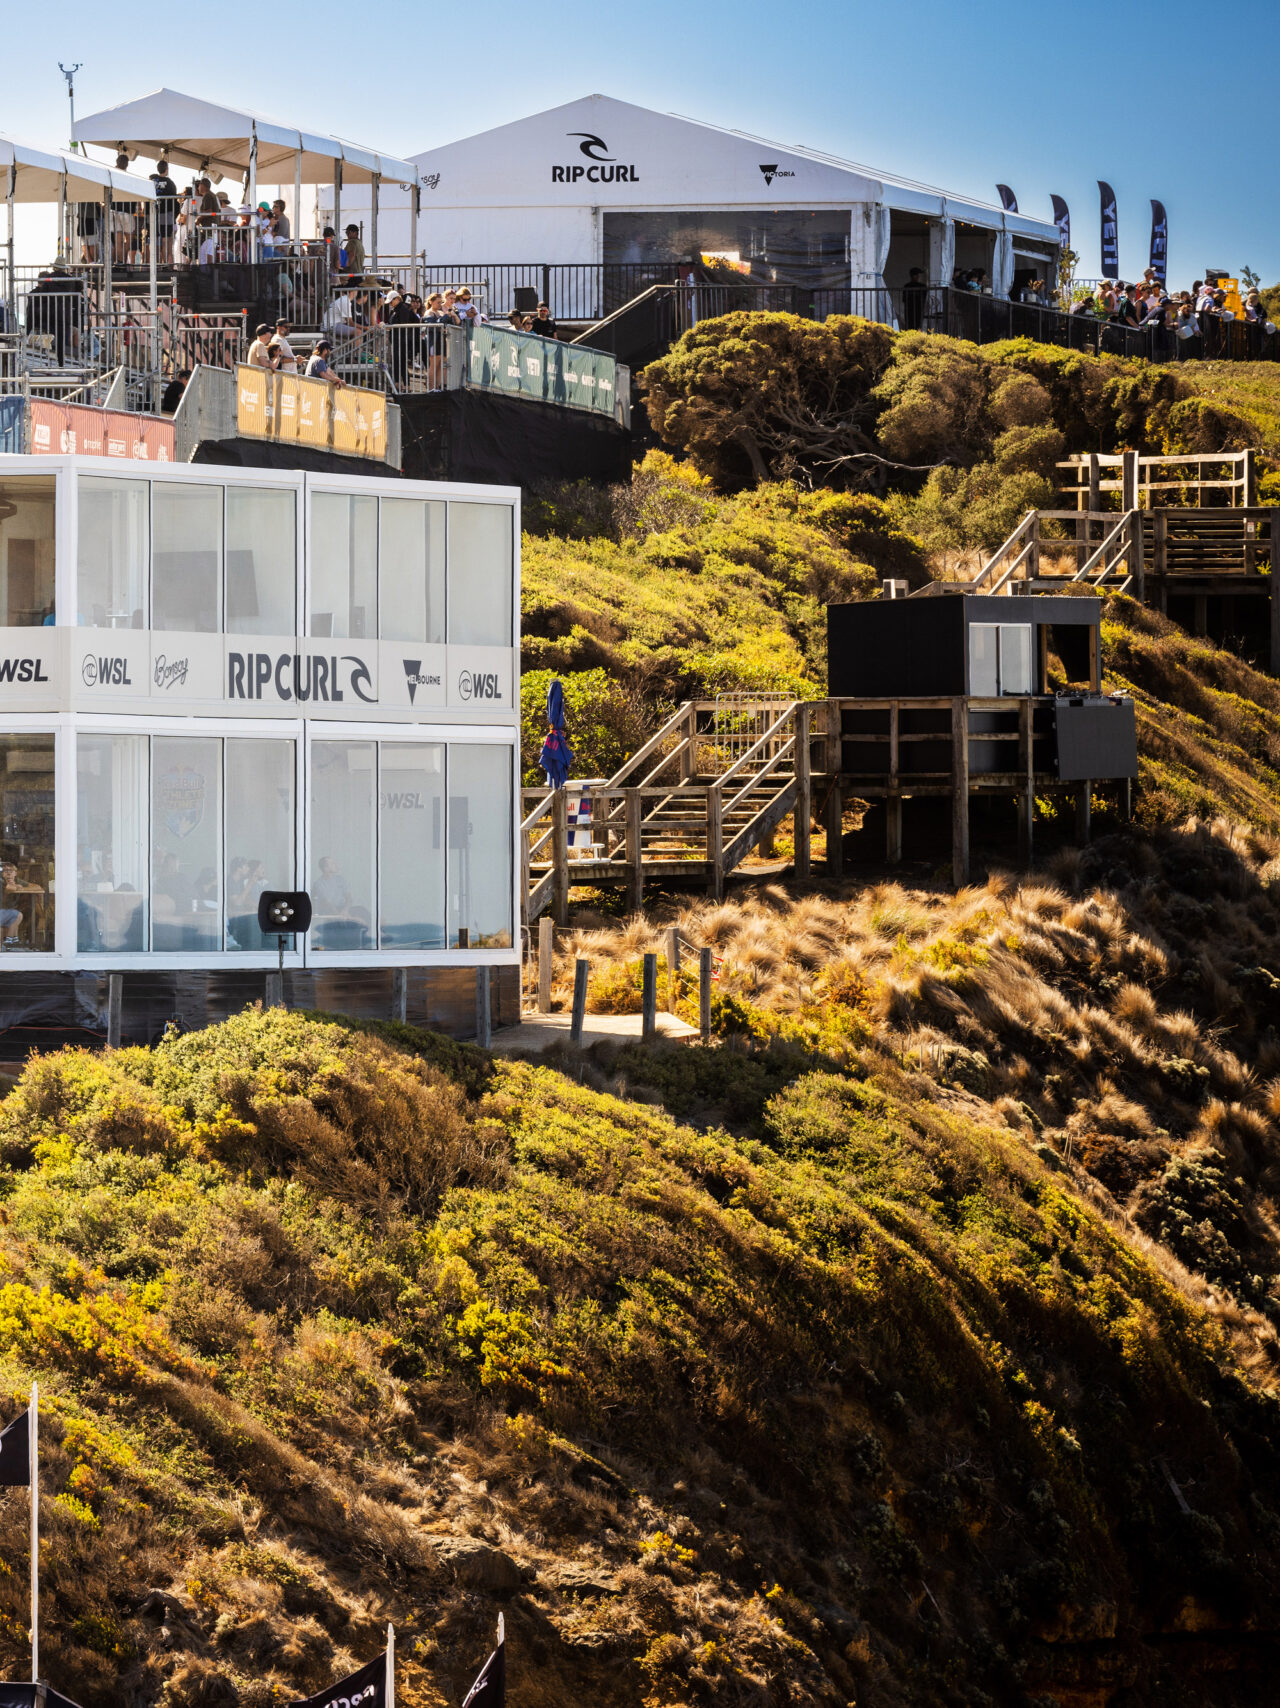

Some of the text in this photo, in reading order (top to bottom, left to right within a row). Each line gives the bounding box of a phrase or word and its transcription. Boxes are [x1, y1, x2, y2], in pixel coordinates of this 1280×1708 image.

[551, 164, 639, 183] RIPCURL
[1103, 200, 1118, 265] YETI
[98, 657, 131, 685] WSL
[154, 654, 188, 690] Bonsoy
[228, 652, 344, 701] RIPCURL
[473, 673, 502, 699] WSL
[387, 793, 425, 809] WSL
